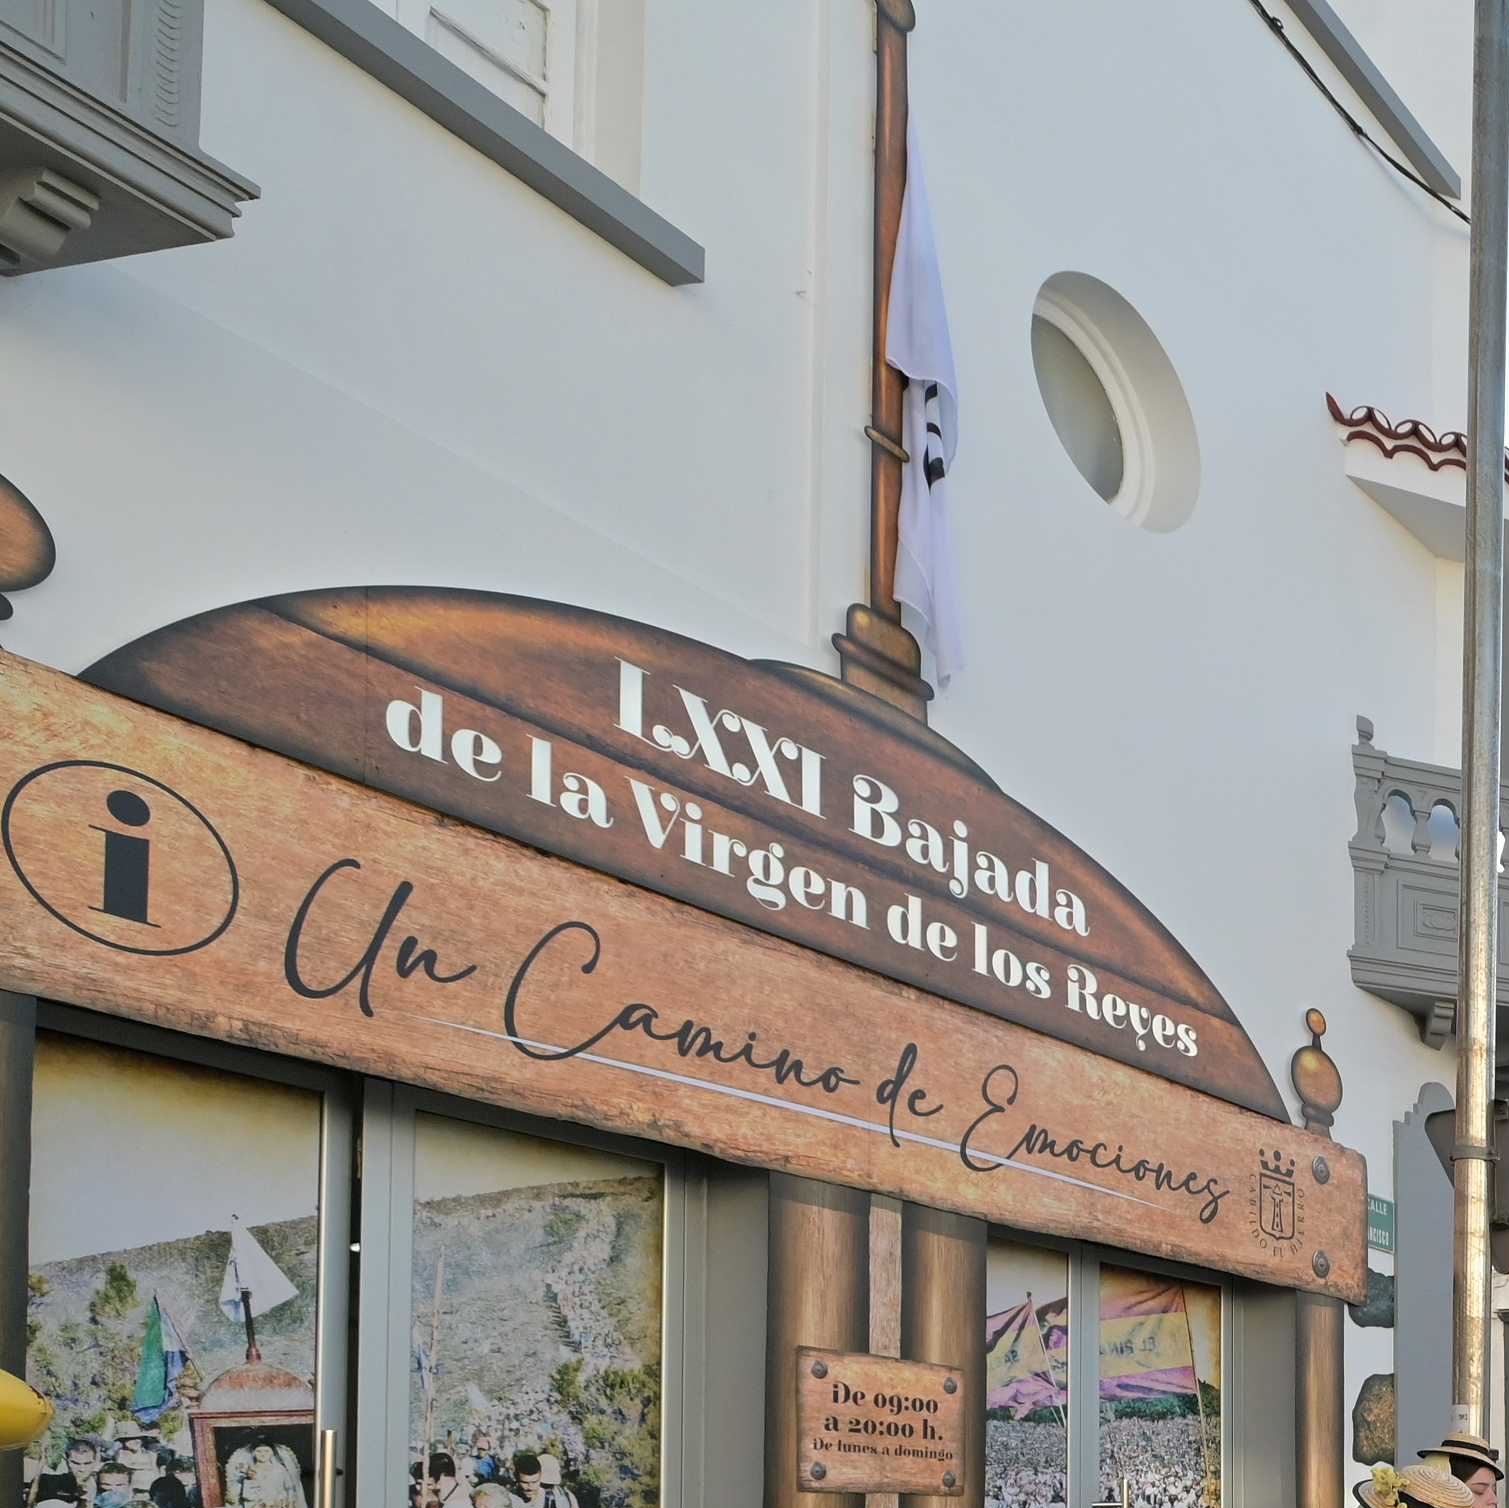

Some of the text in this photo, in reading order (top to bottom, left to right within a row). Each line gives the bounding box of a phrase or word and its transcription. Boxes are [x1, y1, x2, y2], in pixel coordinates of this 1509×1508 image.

[614, 656, 1090, 937] LXXI Bajada
[386, 686, 1198, 1057] de la Virgen de los Reyes
[284, 858, 1230, 1225] Un Camino de Emociones
[1249, 1173, 1267, 1248] CABILDO
[1368, 1226, 1389, 1246] NCISCO
[832, 1381, 939, 1416] De 09:00
[813, 1438, 953, 1462] De lunes a domingo
[824, 1415, 943, 1441] a 20:00 h.
